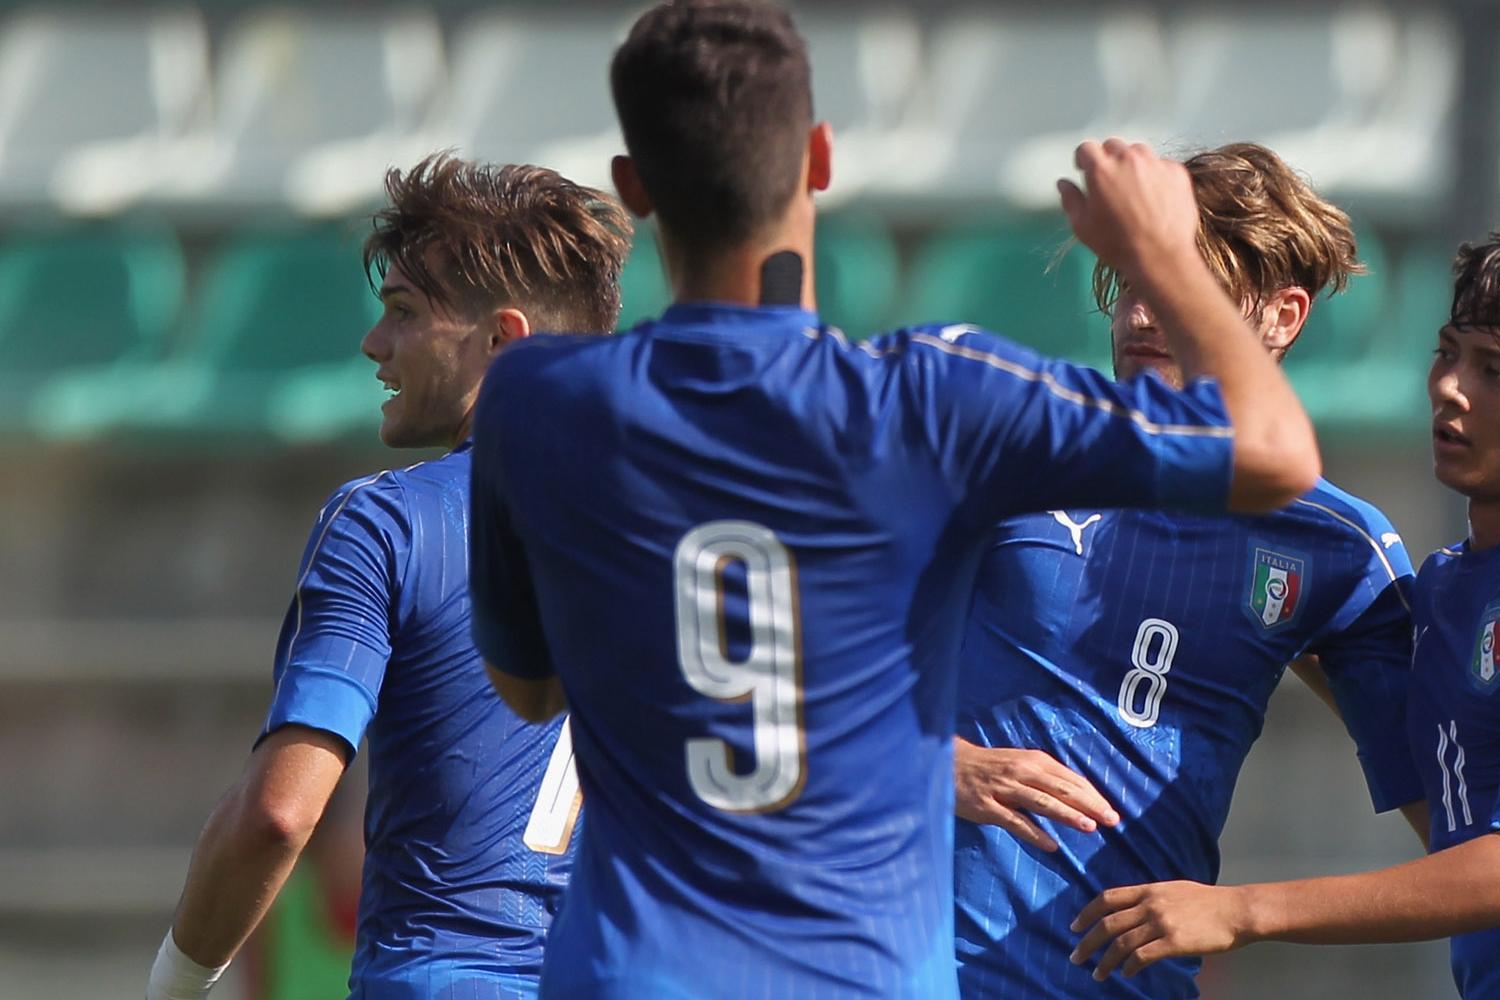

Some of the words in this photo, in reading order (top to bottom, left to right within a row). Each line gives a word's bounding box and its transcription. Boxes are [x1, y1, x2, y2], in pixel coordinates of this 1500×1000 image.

[1261, 554, 1296, 571] ITALIA
[674, 519, 807, 815] 9
[1117, 618, 1180, 728] 8
[1437, 720, 1473, 832] 11
